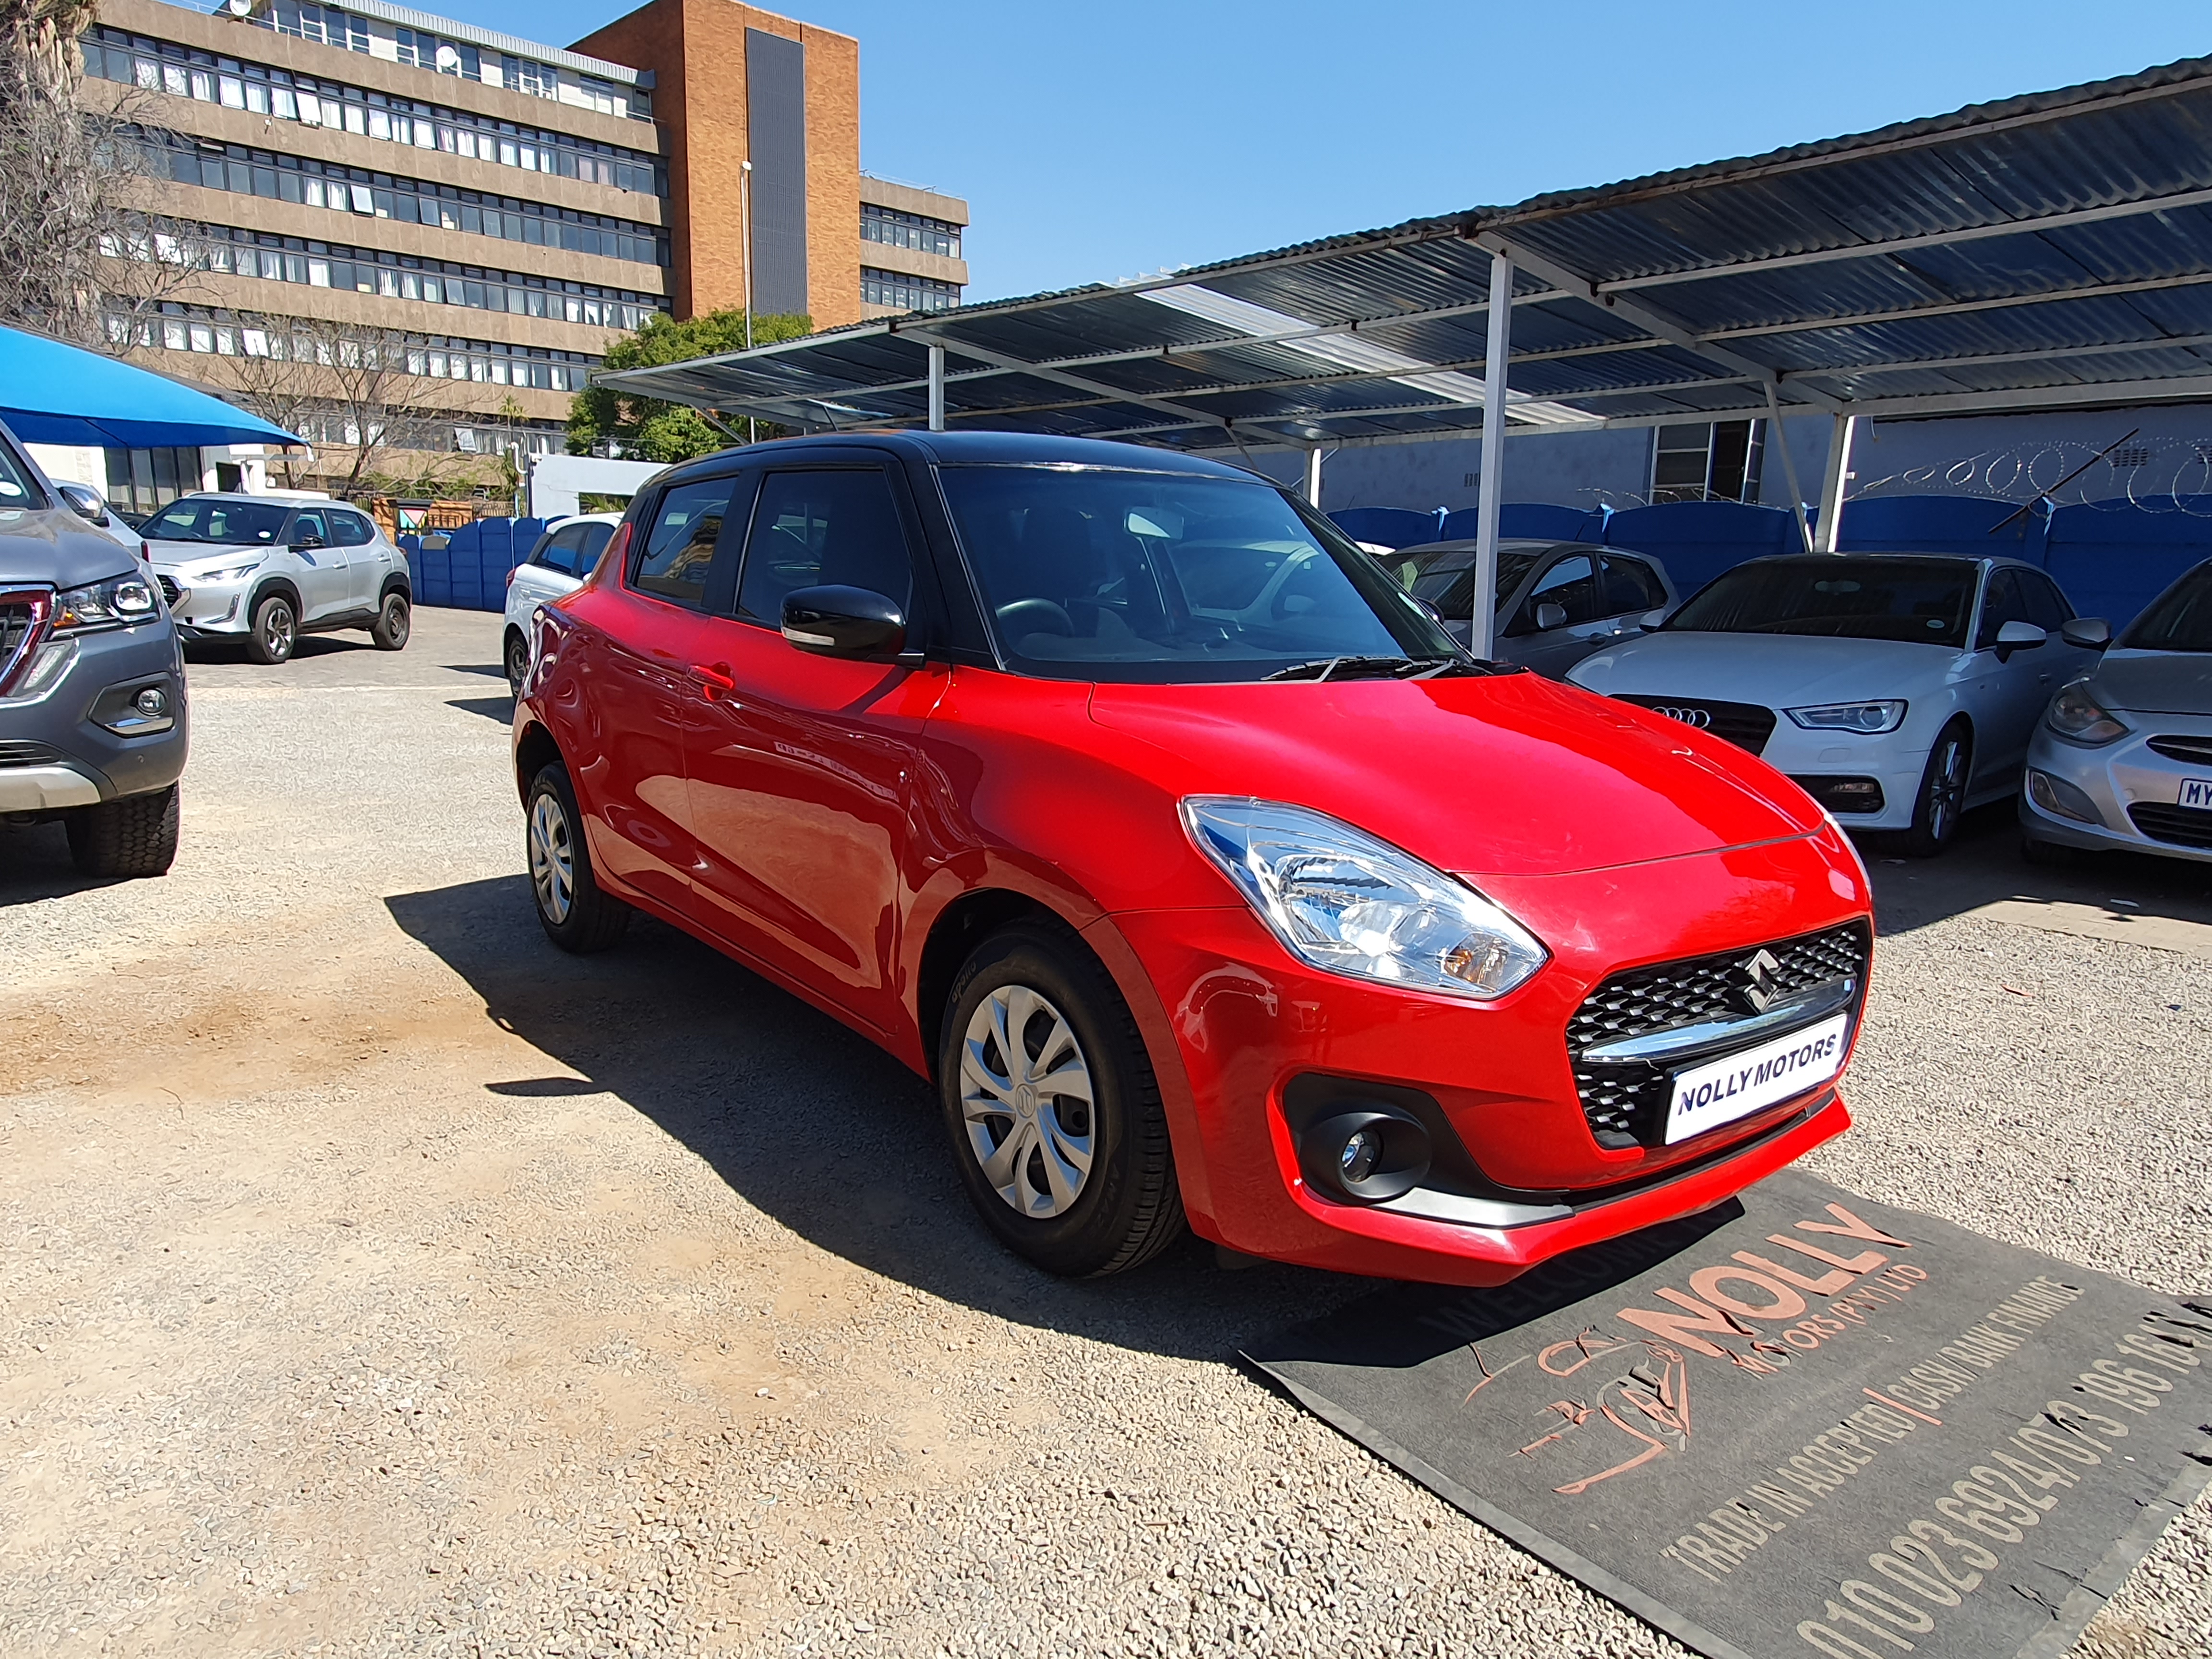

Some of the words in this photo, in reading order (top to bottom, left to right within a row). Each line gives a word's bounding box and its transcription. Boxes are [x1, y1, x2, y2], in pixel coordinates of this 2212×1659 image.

[952, 962, 976, 1003] apollo
[1677, 1067, 1753, 1116] NOLLY
[1753, 1034, 1837, 1086] MOTORS
[1616, 1202, 1913, 1358] NOLLY
[1986, 1275, 2085, 1334] FINANCE
[1777, 1402, 1917, 1499] ACCEPTED
[1659, 1497, 1787, 1583] TRADE
[1745, 1479, 1814, 1518] IN
[1796, 1579, 1935, 1659] 010
[1867, 1519, 1999, 1607] 023
[2071, 1358, 2174, 1416] 196
